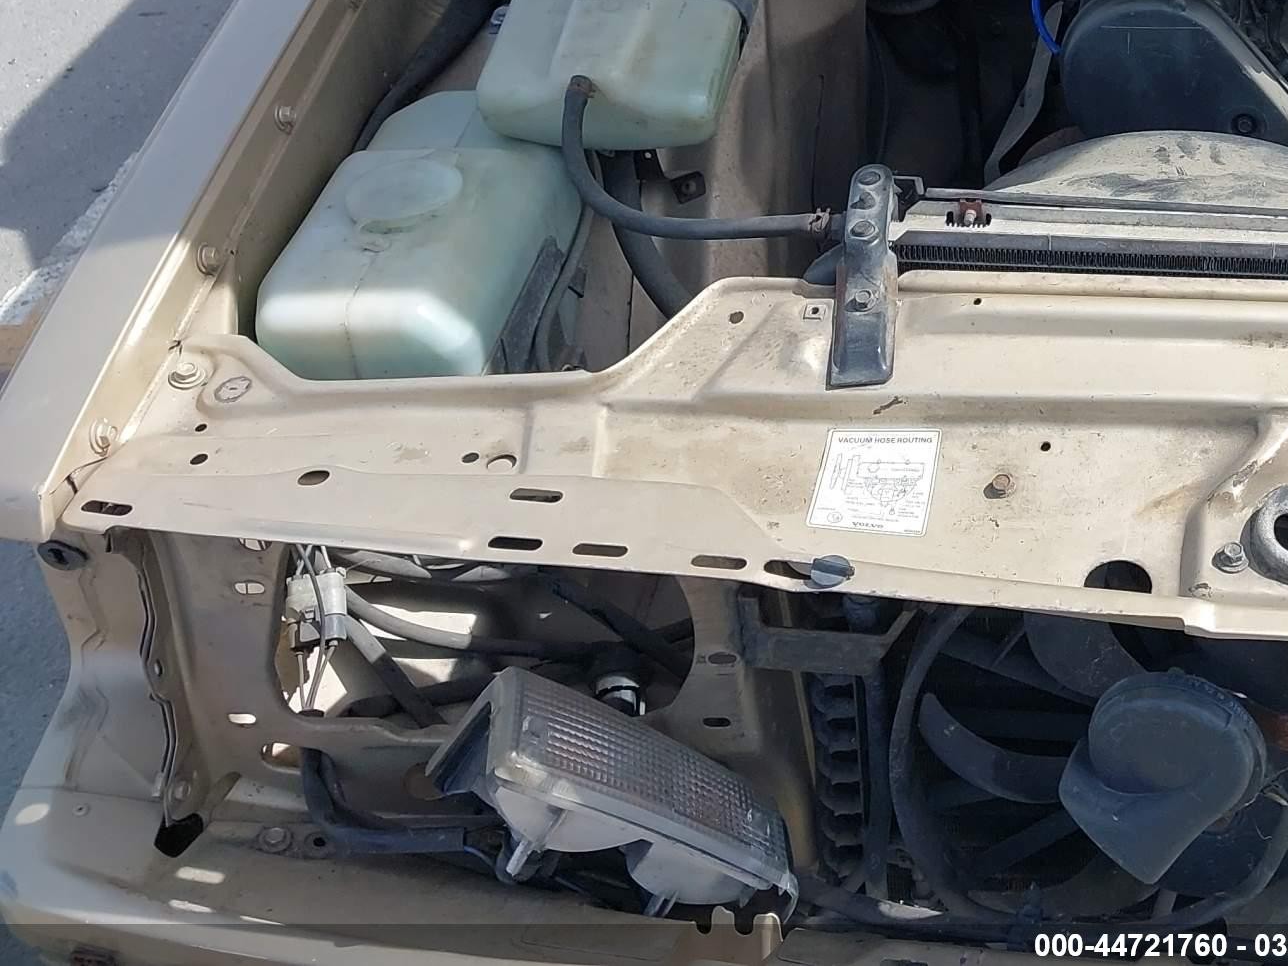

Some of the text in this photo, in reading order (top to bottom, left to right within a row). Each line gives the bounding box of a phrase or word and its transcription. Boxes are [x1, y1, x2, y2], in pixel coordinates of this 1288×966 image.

[838, 436, 933, 444] VACUUM HOSE ROUTING
